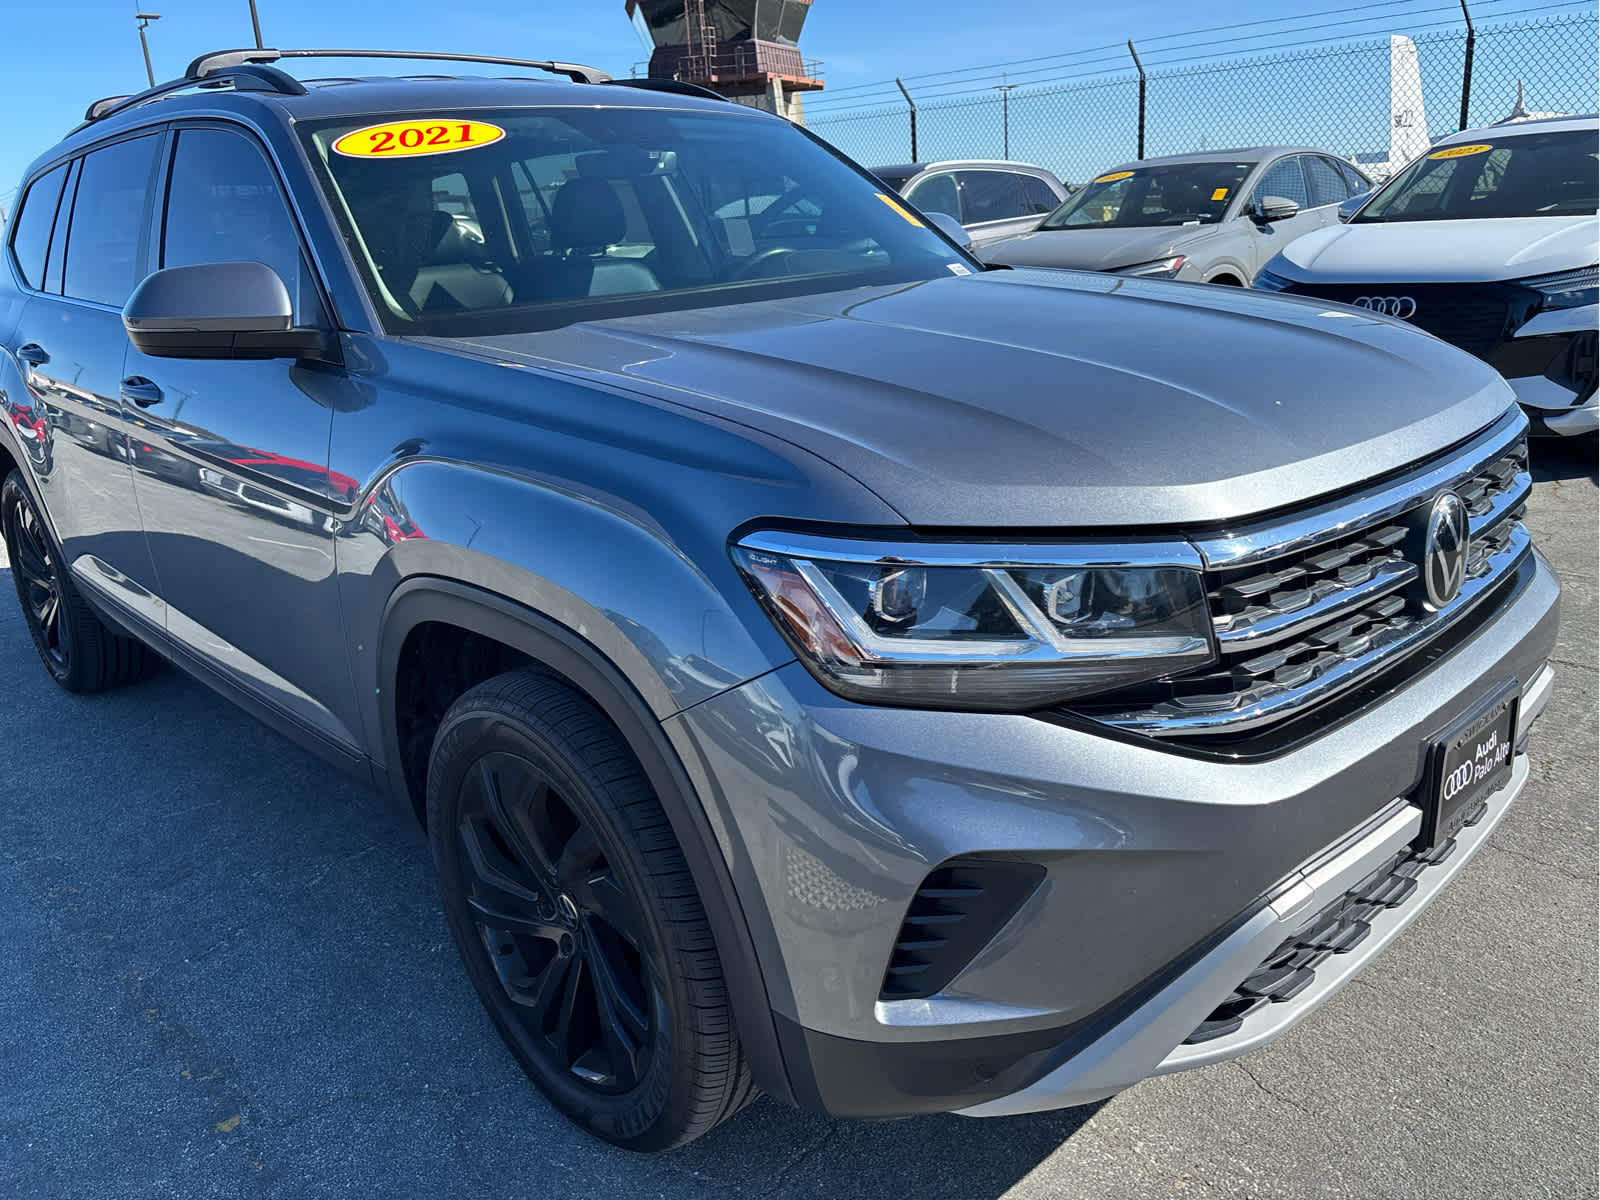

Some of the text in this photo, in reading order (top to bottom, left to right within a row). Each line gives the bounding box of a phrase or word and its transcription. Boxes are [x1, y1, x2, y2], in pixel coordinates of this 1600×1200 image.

[370, 124, 475, 153] 2021
[1475, 730, 1497, 762] Audi
[1473, 741, 1510, 784] Palo Alto
